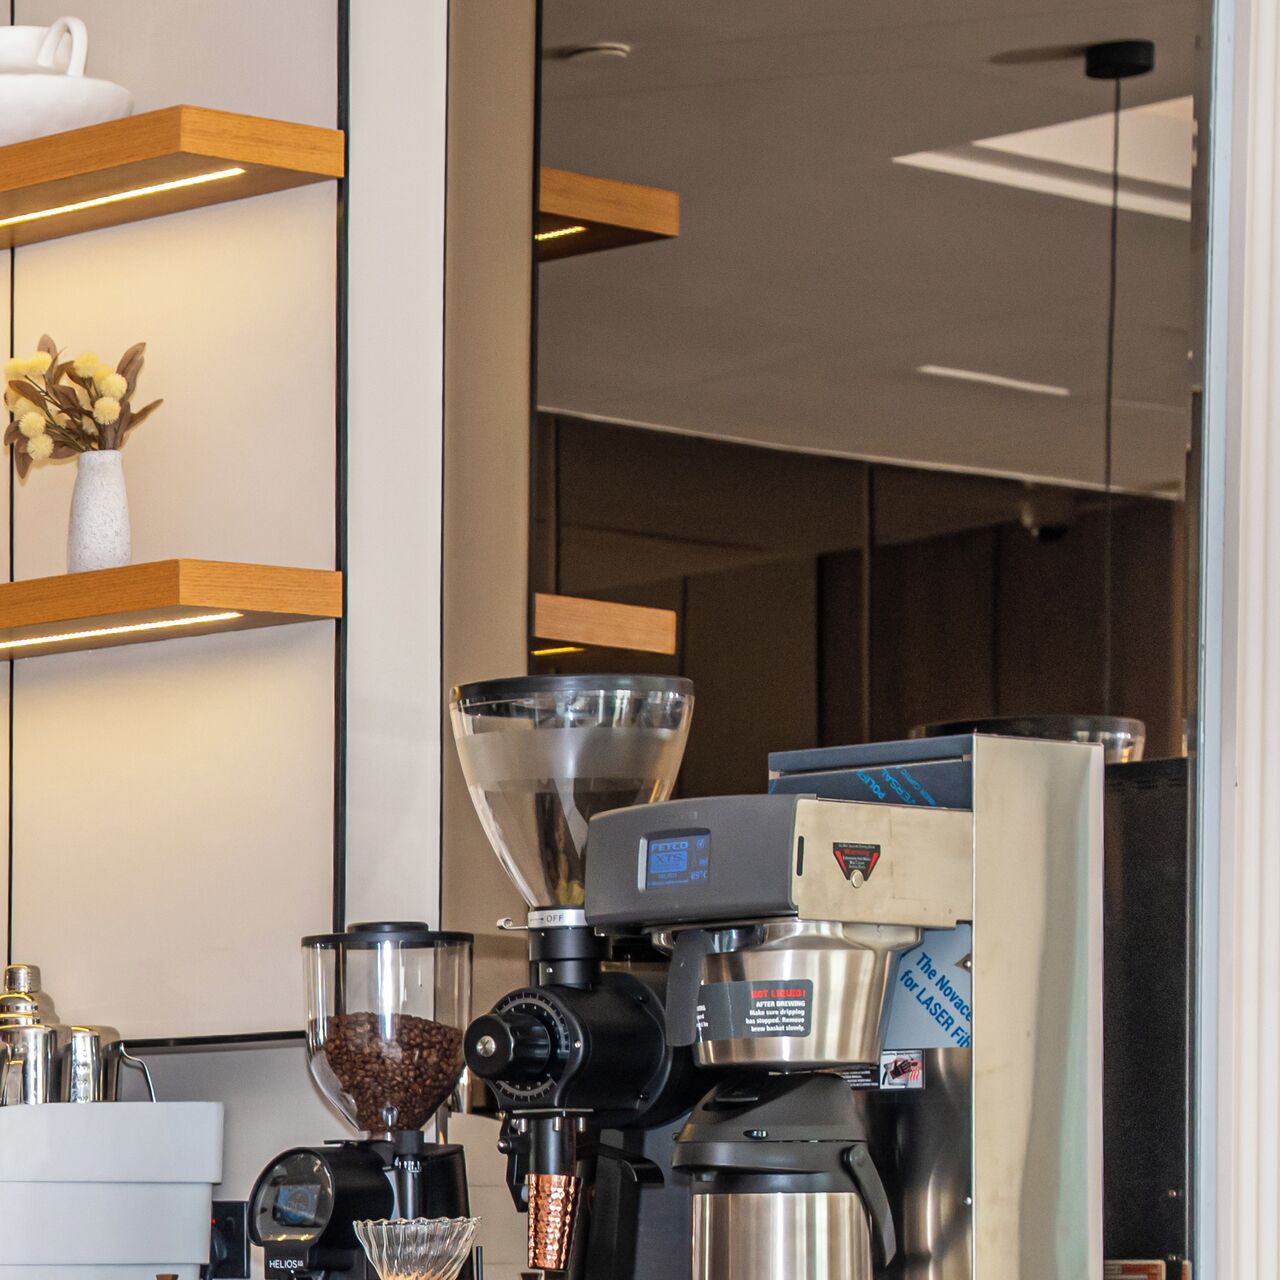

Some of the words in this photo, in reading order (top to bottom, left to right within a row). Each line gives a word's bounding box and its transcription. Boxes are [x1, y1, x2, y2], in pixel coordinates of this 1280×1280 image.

[546, 914, 565, 923] OFF
[915, 951, 938, 980] The
[751, 989, 768, 999] HOT
[900, 969, 920, 992] for
[915, 987, 955, 1031] LASER
[780, 1008, 805, 1016] dripping
[269, 1259, 298, 1269] HELIOS
